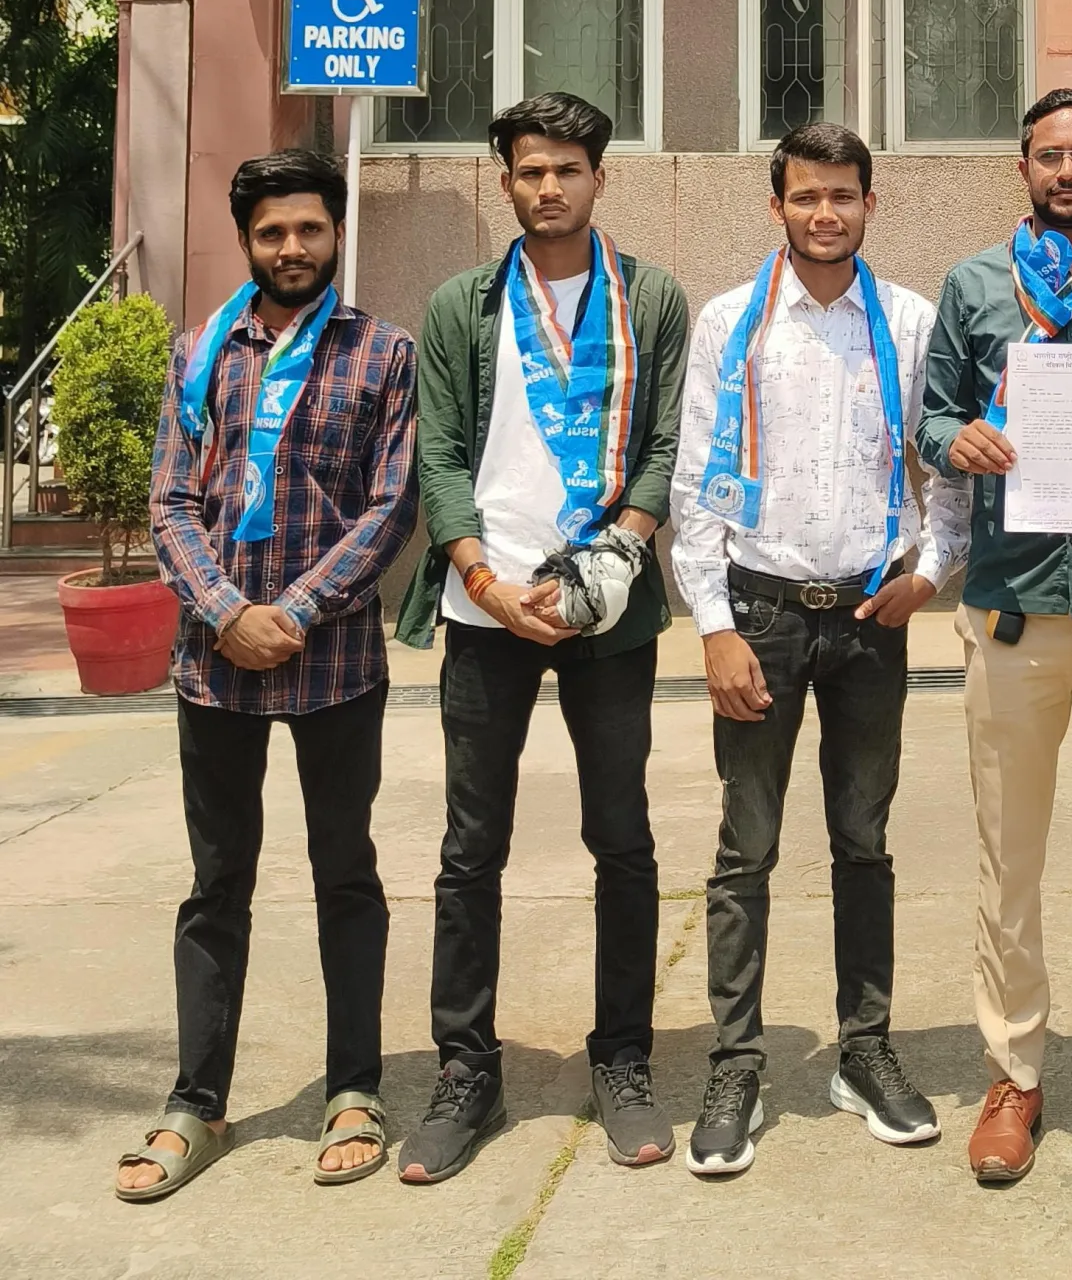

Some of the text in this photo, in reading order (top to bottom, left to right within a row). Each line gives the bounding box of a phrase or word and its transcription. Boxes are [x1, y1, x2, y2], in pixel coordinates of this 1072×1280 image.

[304, 25, 406, 50] PARKING
[324, 54, 381, 78] ONLY
[256, 417, 283, 429] NSUI
